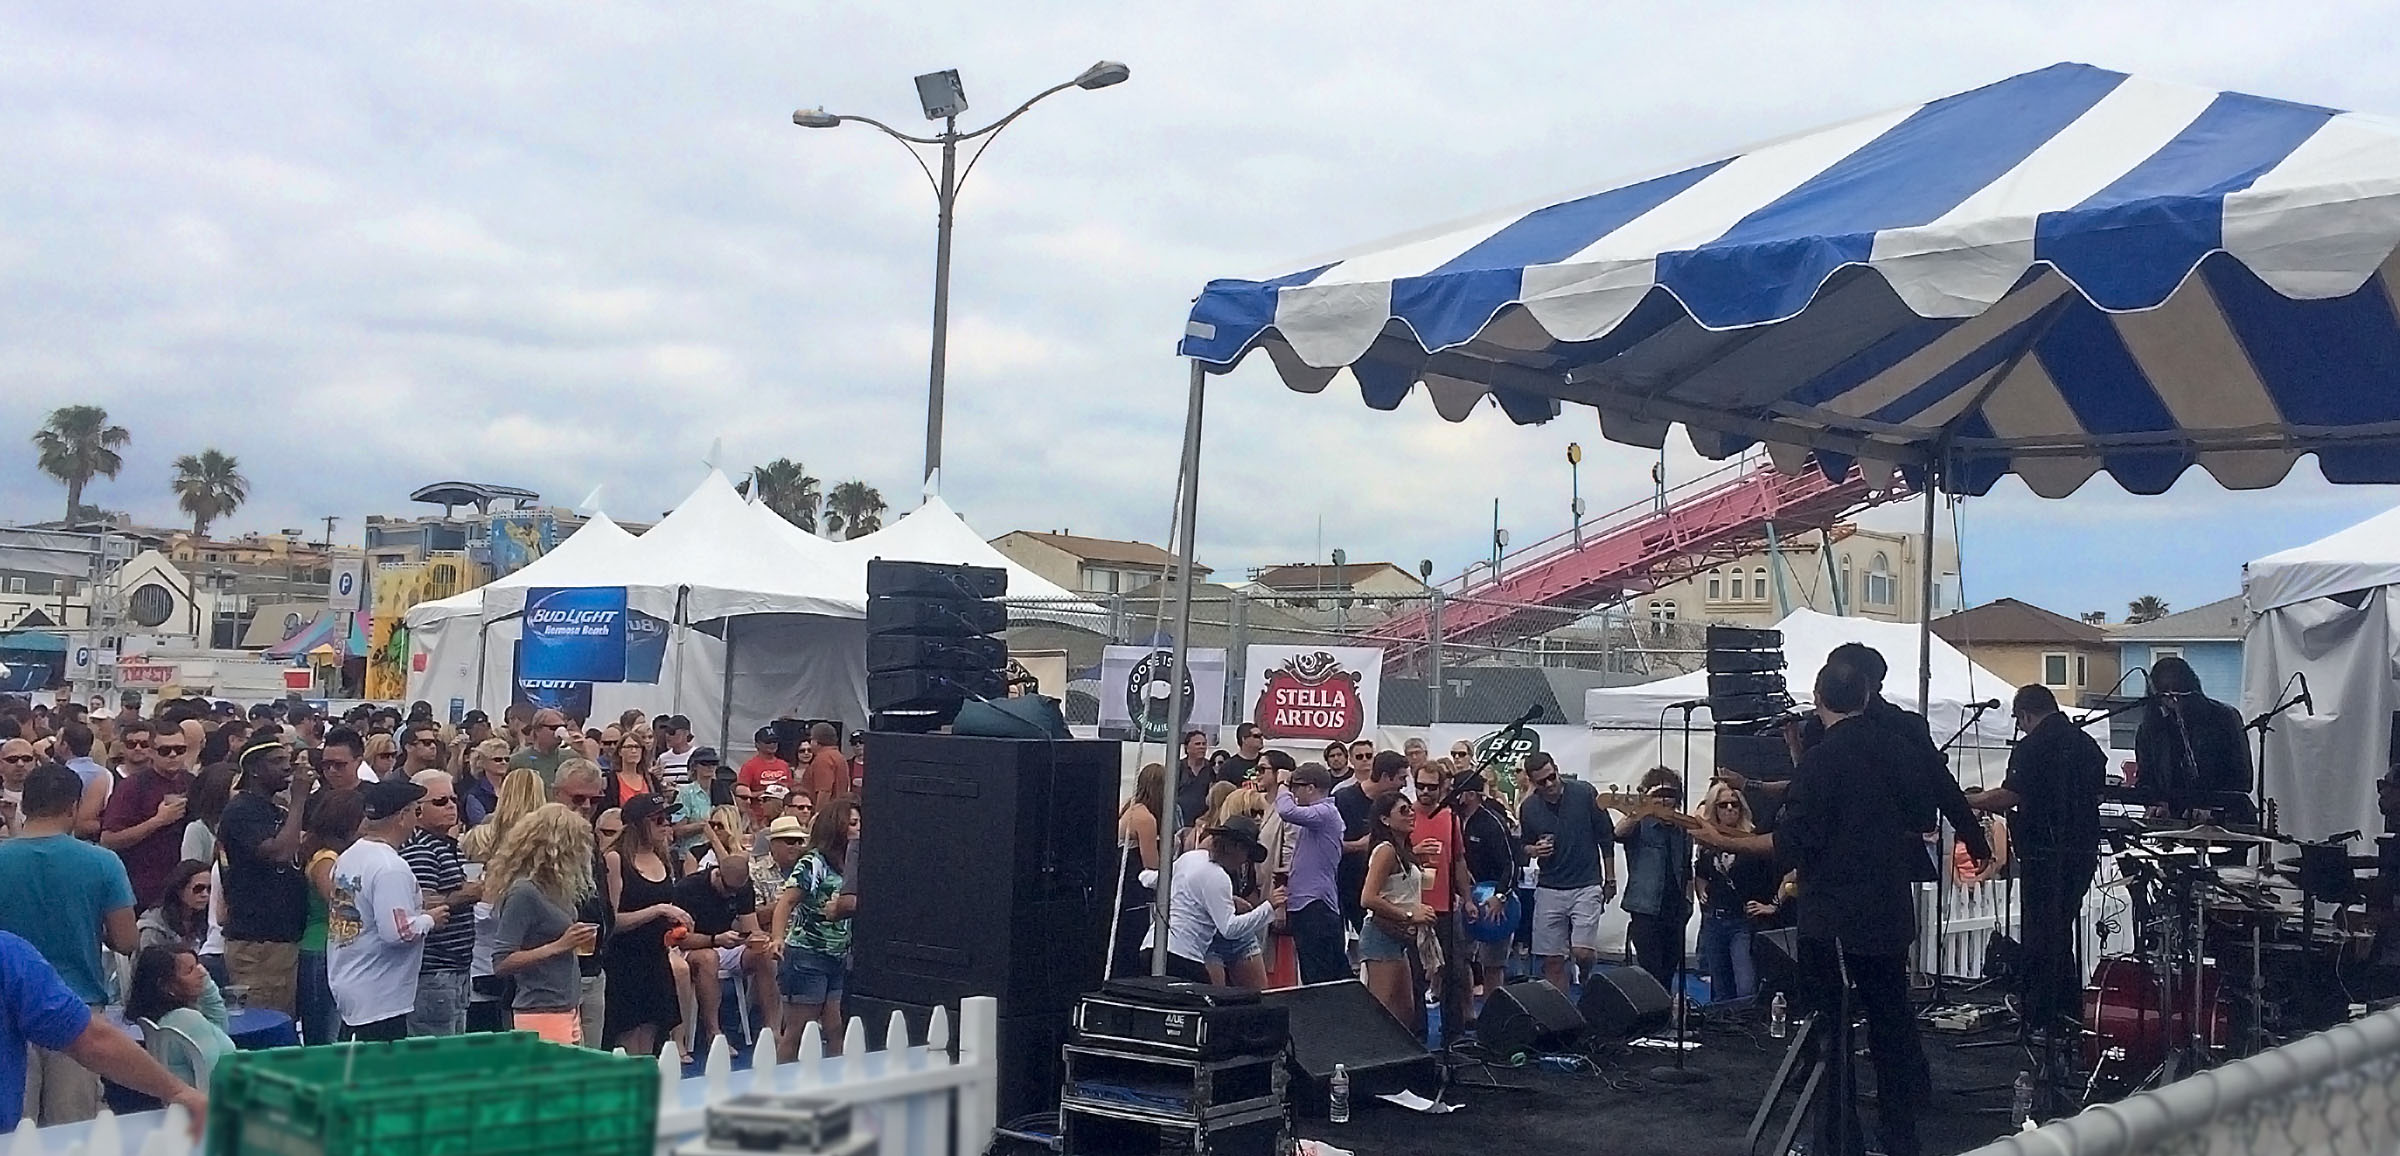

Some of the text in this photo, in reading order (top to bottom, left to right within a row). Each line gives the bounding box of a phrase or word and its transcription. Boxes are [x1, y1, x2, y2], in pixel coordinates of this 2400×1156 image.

[342, 576, 351, 592] P
[533, 608, 619, 624] BUD LIGHT
[544, 625, 609, 636] Hermosa Beach
[79, 649, 88, 664] P
[1276, 688, 1346, 708] STELLA
[1274, 708, 1345, 728] ARTOIS
[1488, 738, 1533, 751] BUD
